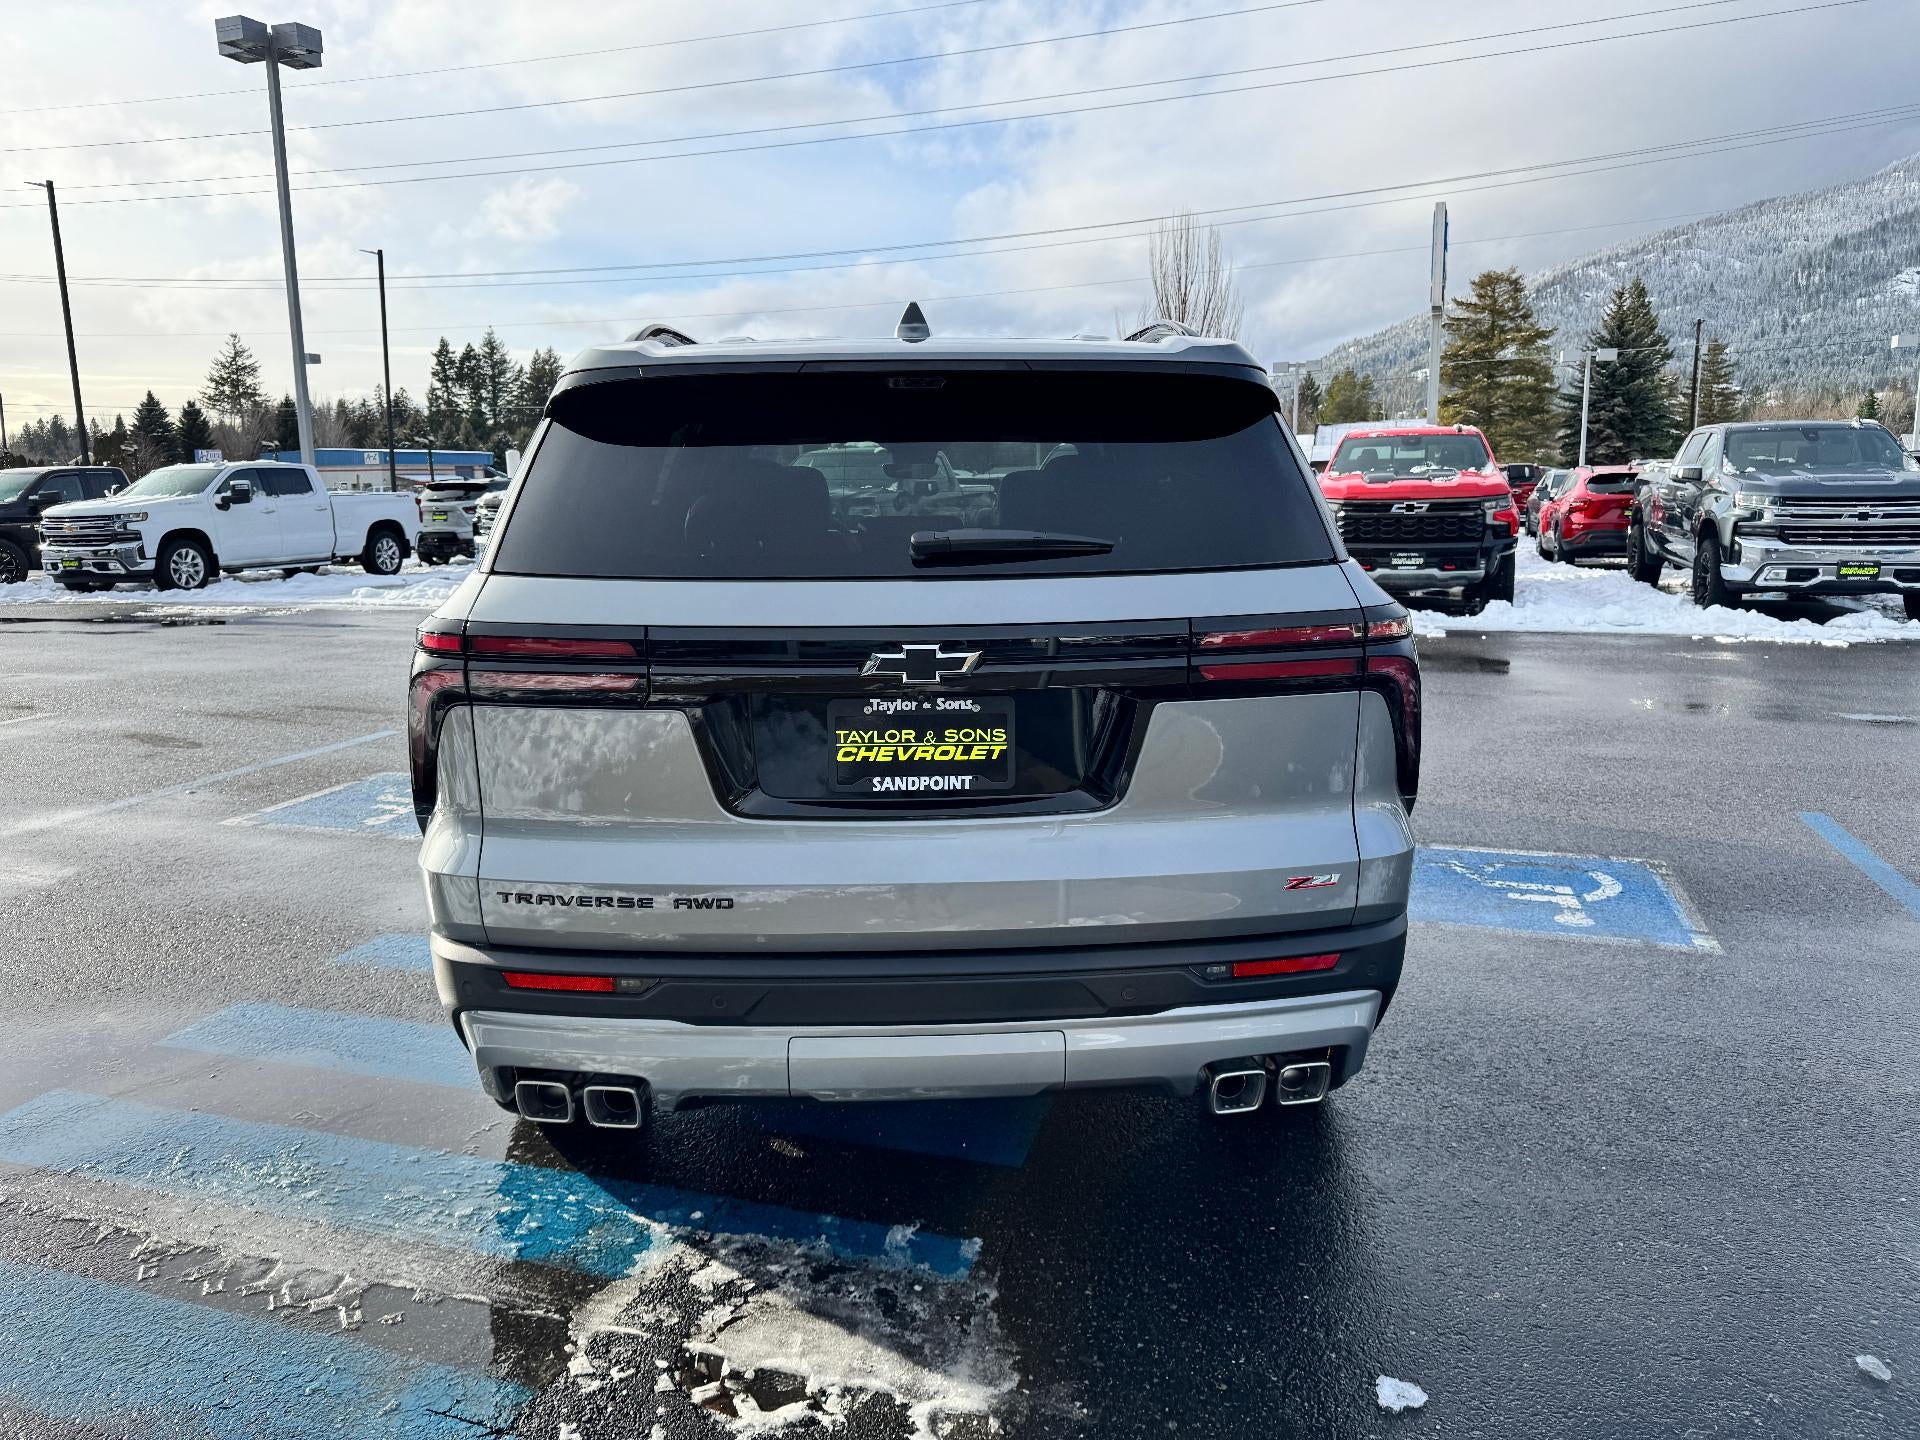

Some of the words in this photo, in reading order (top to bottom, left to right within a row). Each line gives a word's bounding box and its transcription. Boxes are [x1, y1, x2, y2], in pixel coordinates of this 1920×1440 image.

[870, 699, 918, 714] Taylor
[936, 698, 973, 710] Sons
[836, 730, 916, 743] TAYLOR
[923, 730, 937, 745] &
[944, 728, 1007, 742] SONS
[836, 745, 1008, 762] CHEVROLET
[872, 775, 973, 791] SANDPOINT
[496, 891, 655, 909] TRAVERSE
[673, 897, 735, 910] AWD
